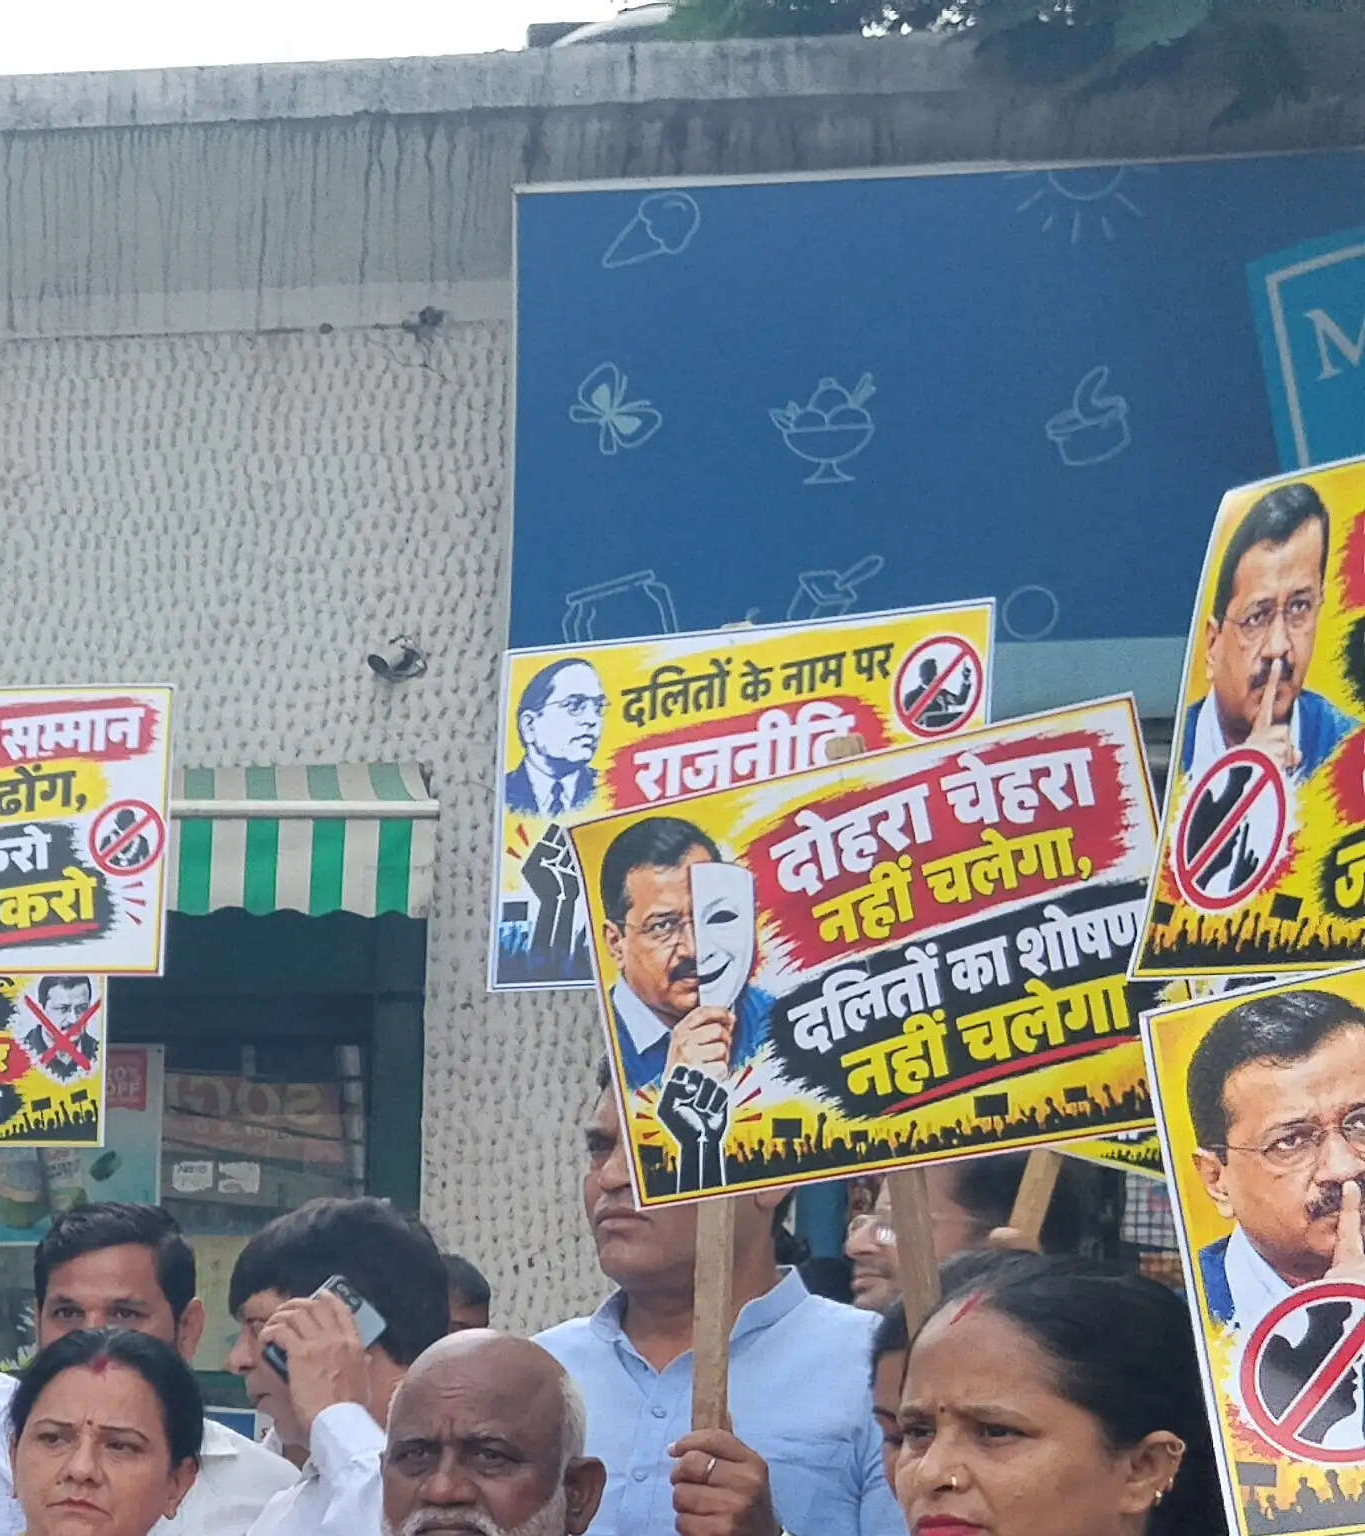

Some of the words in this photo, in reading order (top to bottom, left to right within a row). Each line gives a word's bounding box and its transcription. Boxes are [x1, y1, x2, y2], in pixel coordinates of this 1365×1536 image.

[2, 706, 146, 762] सम्मान
[621, 656, 734, 727] दलितों
[740, 659, 774, 703] के
[780, 651, 846, 697] नाम
[853, 642, 895, 682] पर
[770, 808, 929, 898] दोहरा
[940, 748, 1095, 829] चेहरा
[812, 854, 917, 947] नहीं
[922, 827, 1094, 907] चलेगा,
[786, 942, 943, 1055] दलितों
[947, 937, 1011, 994] का
[1017, 898, 1143, 974] शोषण
[841, 1016, 956, 1099] नहीं
[954, 974, 1131, 1066] चलेगा
